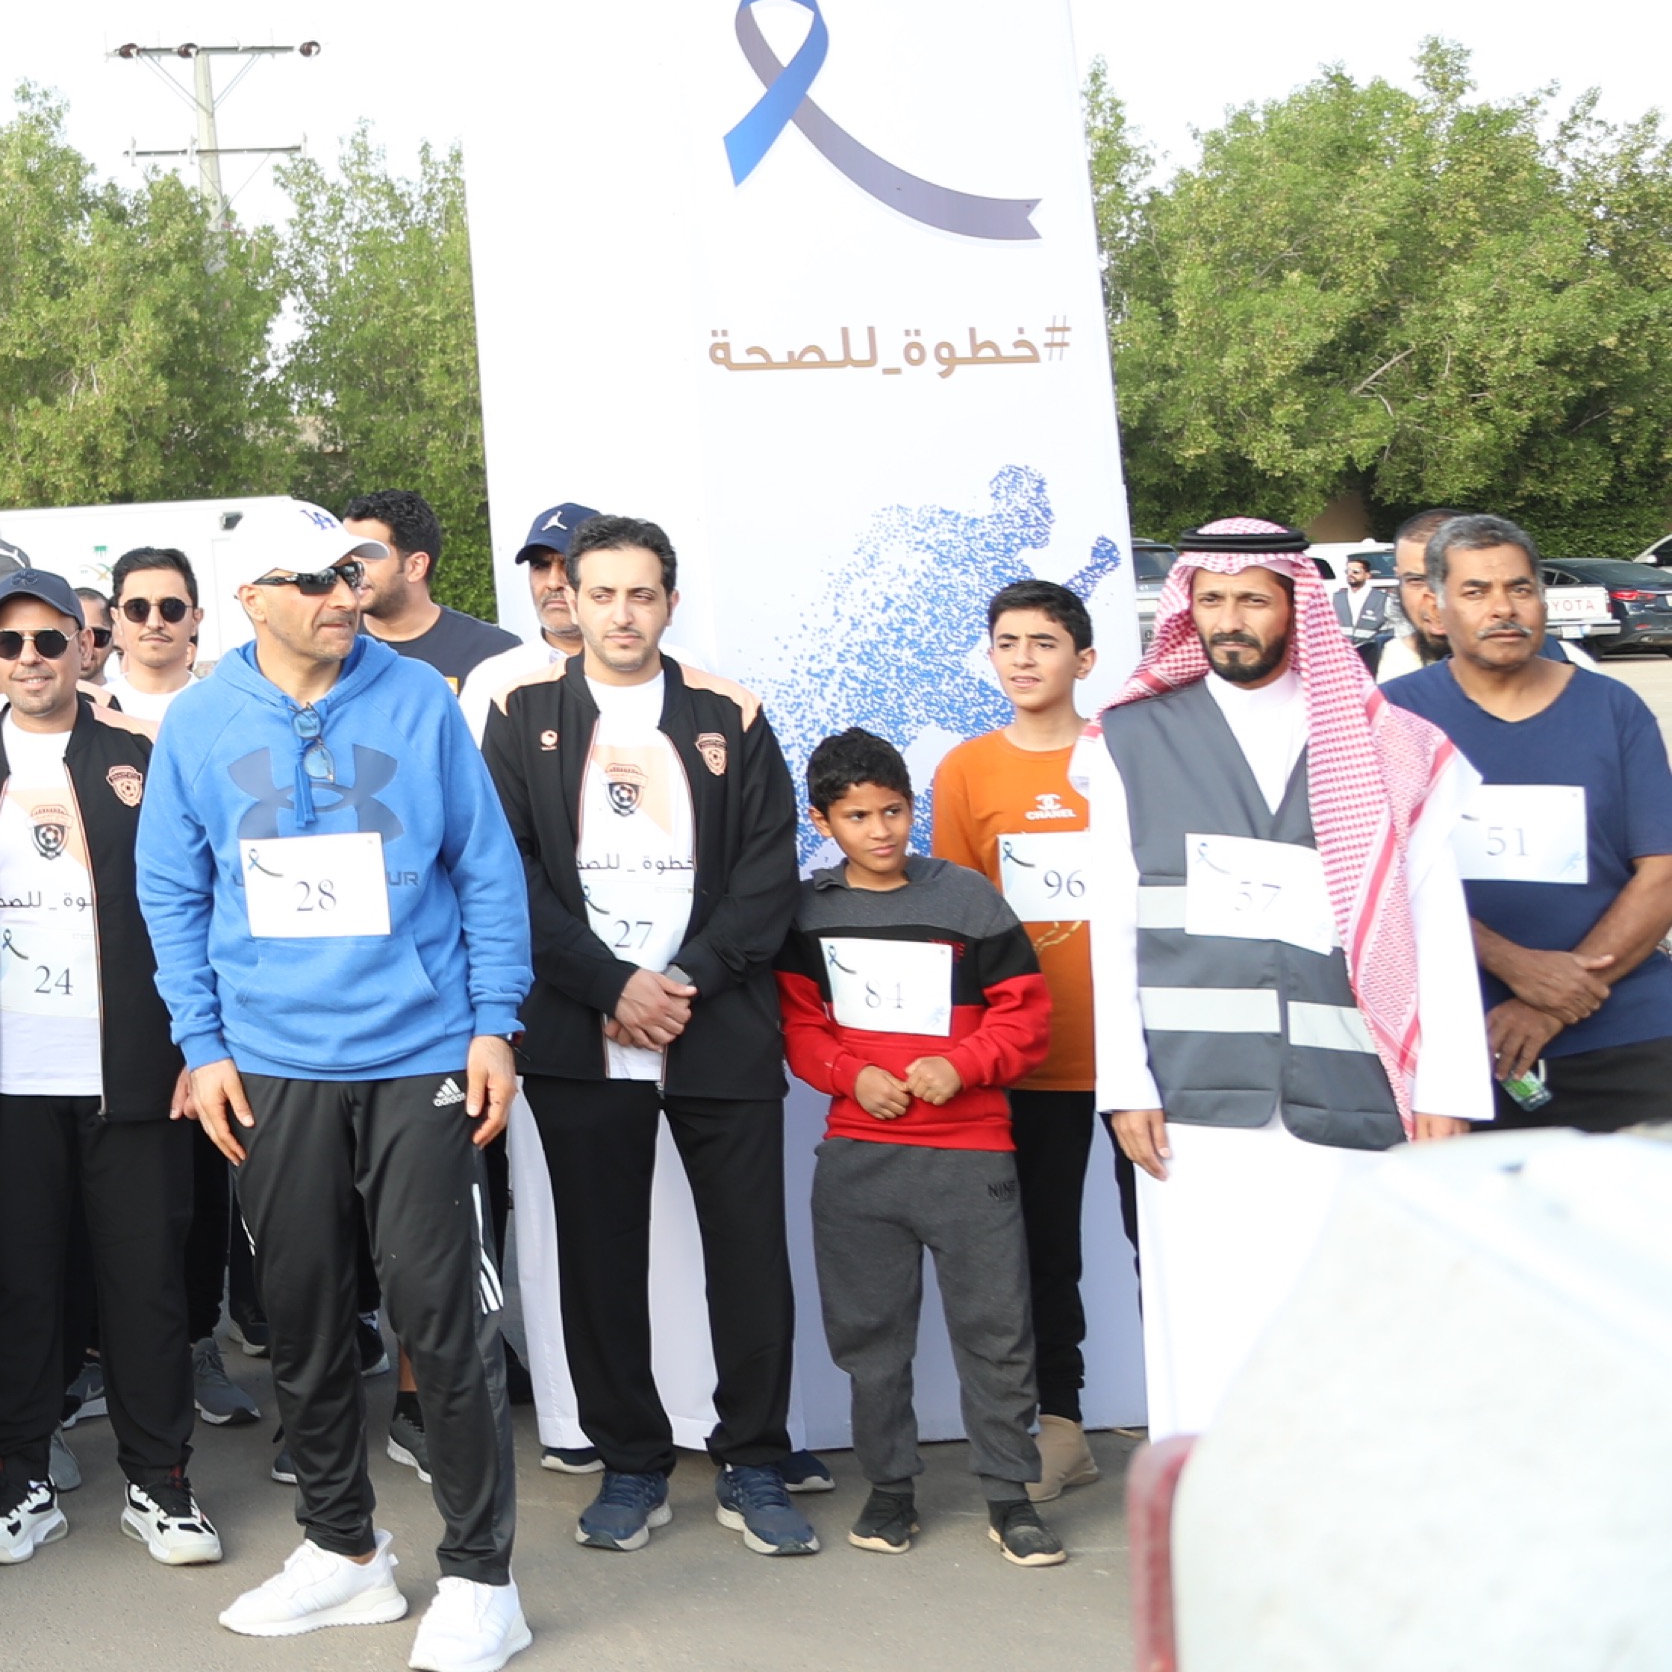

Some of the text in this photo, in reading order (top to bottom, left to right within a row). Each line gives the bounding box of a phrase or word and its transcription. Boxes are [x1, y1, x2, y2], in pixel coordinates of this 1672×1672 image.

[708, 315, 1072, 379] #خطوة_للصحة
[1546, 599, 1595, 612] YOTA
[1024, 808, 1077, 821] CHANEL
[1486, 826, 1529, 856] 51
[295, 879, 337, 912] 28
[1043, 869, 1086, 899] 96
[1233, 880, 1283, 913] 57
[613, 919, 654, 950] 27
[33, 965, 73, 995] 24
[865, 979, 904, 1009] 84
